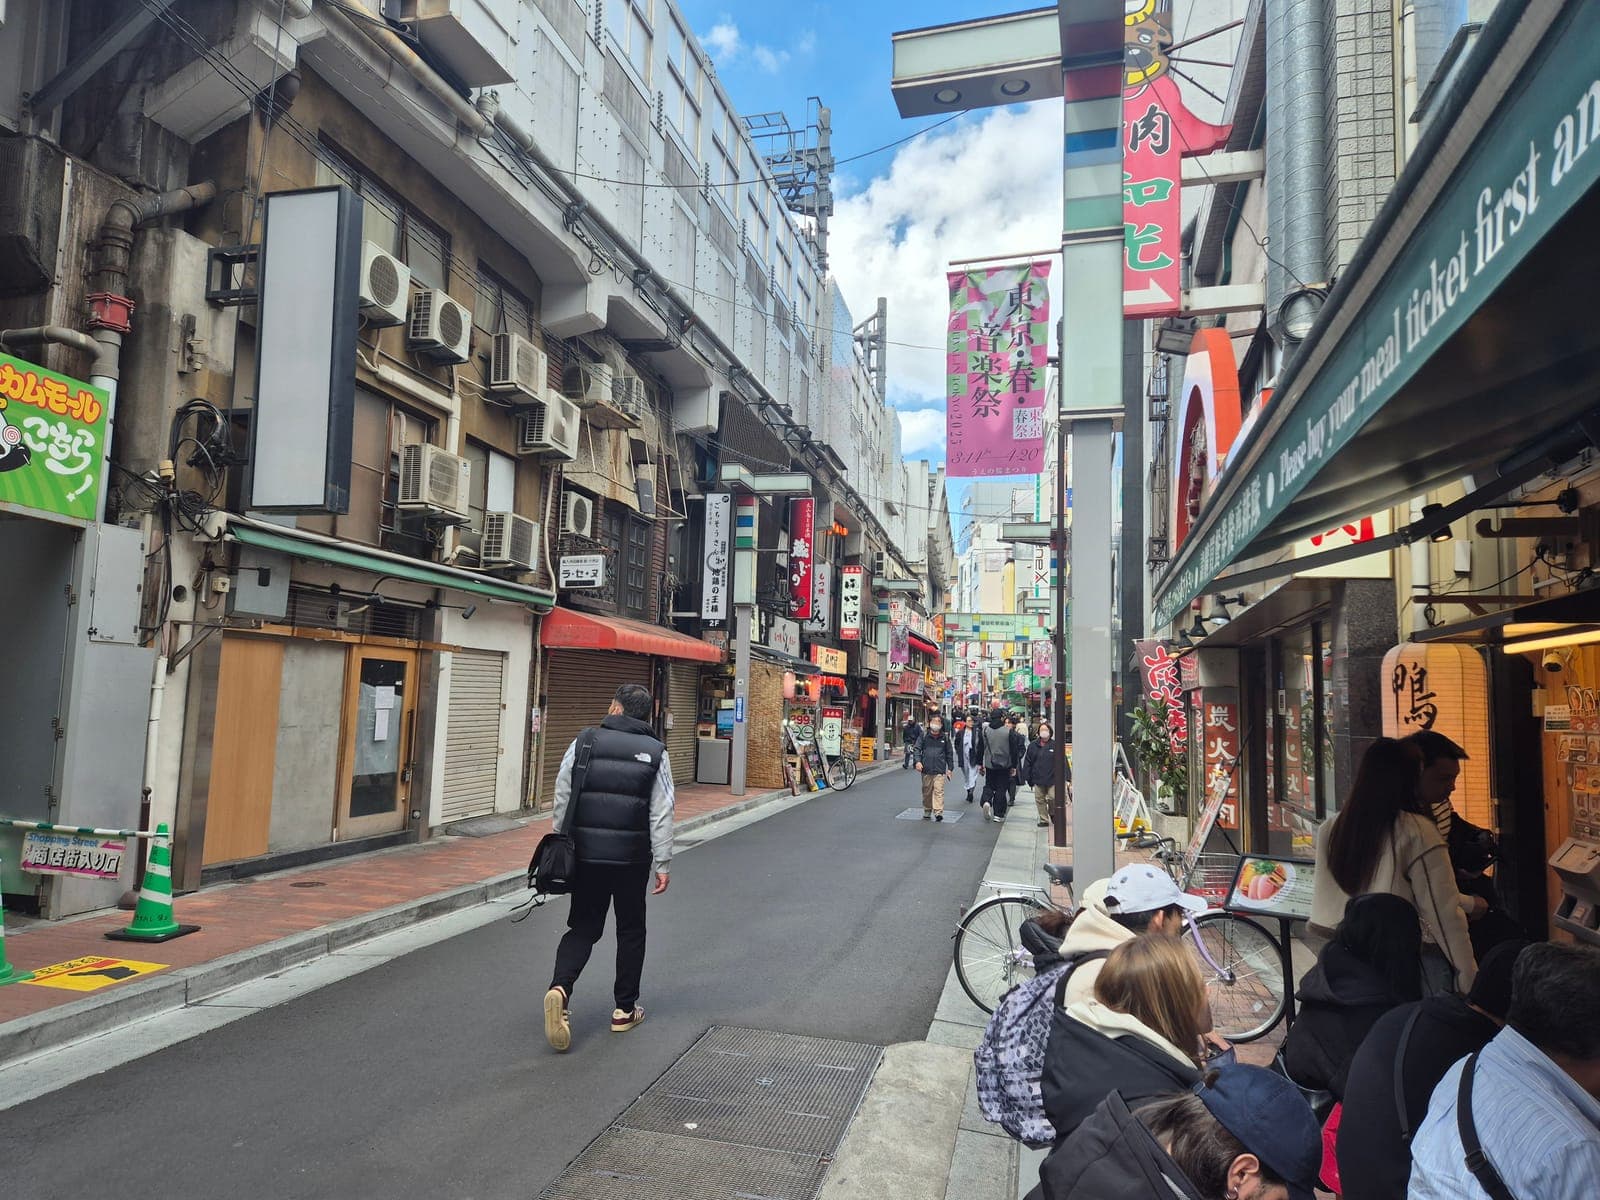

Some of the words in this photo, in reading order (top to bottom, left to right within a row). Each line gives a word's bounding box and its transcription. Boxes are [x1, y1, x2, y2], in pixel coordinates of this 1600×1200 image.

[1279, 446, 1306, 492] Please
[1306, 417, 1327, 459] buy
[1327, 374, 1360, 448] your
[1360, 304, 1401, 404] meal
[1405, 229, 1470, 352] ticket
[1472, 140, 1541, 277] first
[971, 322, 1002, 419] 音楽祭
[951, 375, 961, 413] TOKYO
[562, 569, 599, 578] ラ・セ・ヌ
[709, 619, 720, 627] 2F
[1392, 661, 1438, 730] 鴨
[27, 832, 69, 846] Shopping
[71, 837, 100, 848] Street
[30, 847, 121, 875] 商店街入り口
